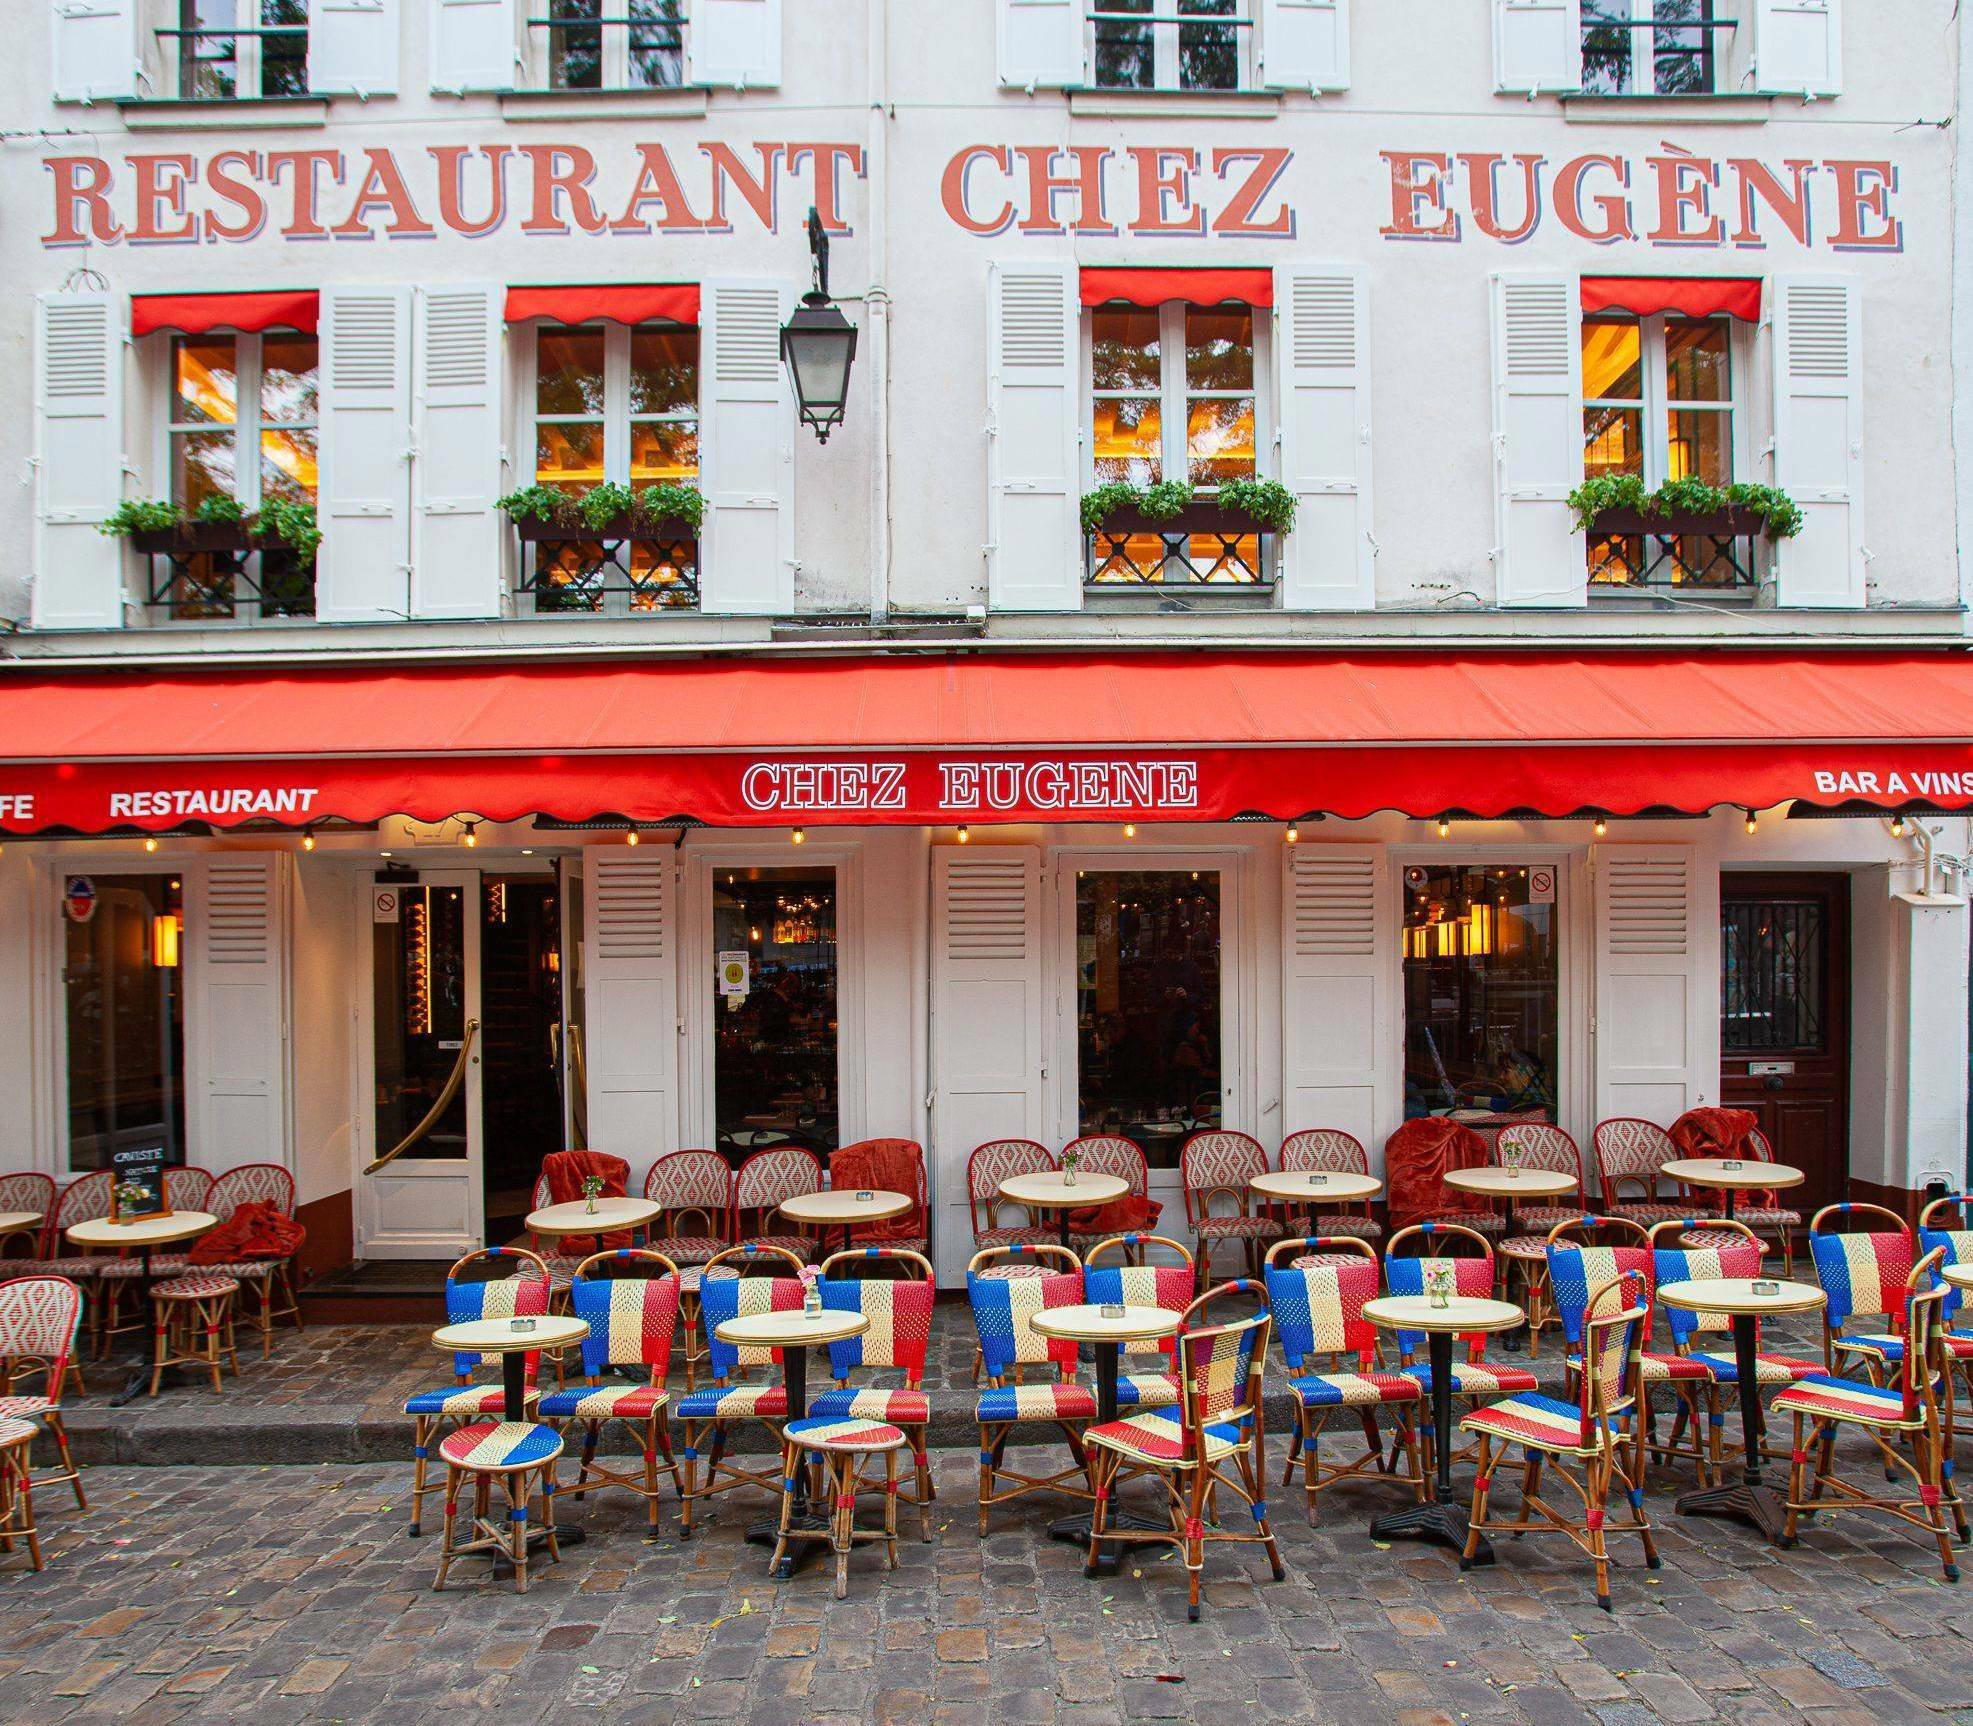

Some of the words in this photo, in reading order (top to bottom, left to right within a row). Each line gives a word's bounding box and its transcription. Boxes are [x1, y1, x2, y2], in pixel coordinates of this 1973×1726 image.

[41, 141, 867, 247] RESTAURANT
[940, 144, 1297, 239] CHEZ
[1379, 140, 1904, 253] EUGÈNE
[110, 788, 318, 817] RESTAURANT
[741, 762, 906, 810] CHEZ
[939, 762, 1197, 808] EUGENE
[1813, 771, 1881, 794] BAR
[1887, 772, 1909, 794] A
[1910, 772, 1973, 796] VINS
